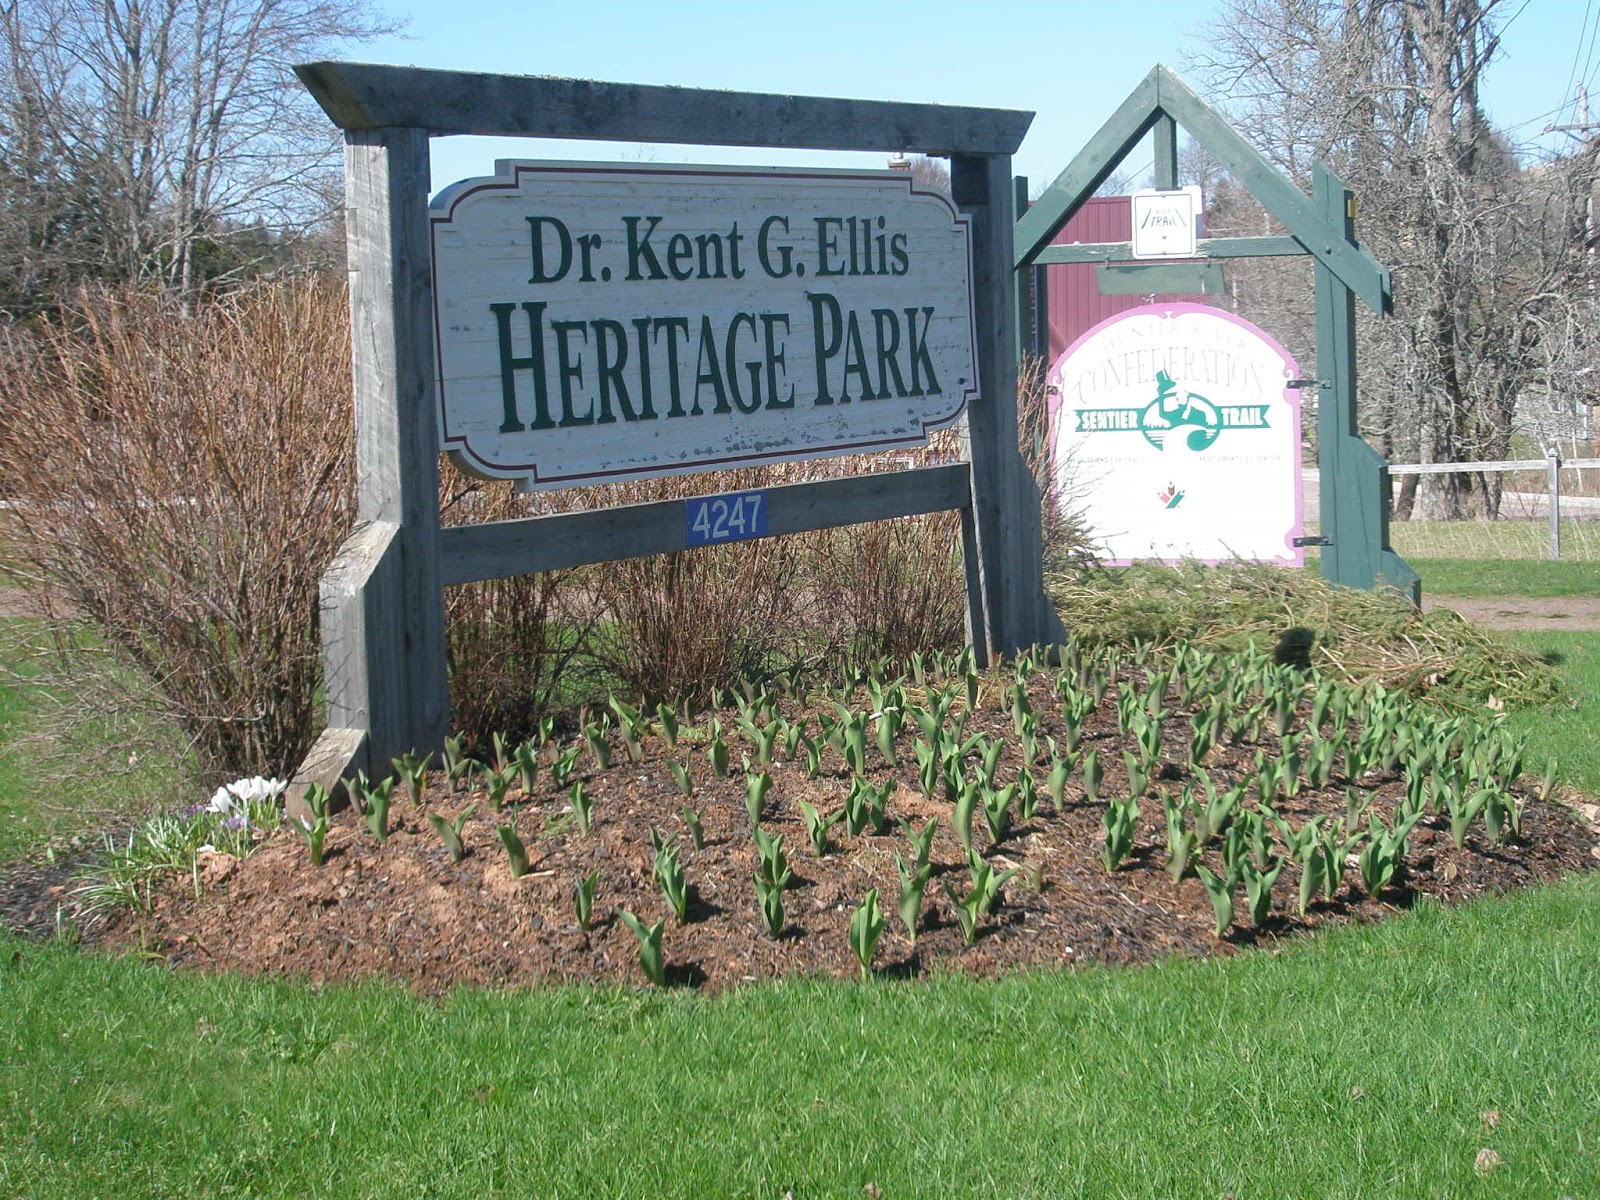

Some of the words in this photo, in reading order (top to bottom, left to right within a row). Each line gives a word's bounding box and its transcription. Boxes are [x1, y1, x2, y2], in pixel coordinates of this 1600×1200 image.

[1151, 211, 1178, 229] TRAIL
[525, 215, 612, 284] Dr.
[622, 215, 746, 281] Kent
[758, 215, 806, 279] G.
[814, 215, 910, 277] Ellis
[490, 301, 796, 434] HERITAGE
[805, 290, 943, 406] PARK
[1078, 346, 1265, 405] CONFEDERATION
[1081, 410, 1139, 430] SENTIER
[1221, 406, 1264, 427] TRAIL
[692, 495, 762, 540] 4247
